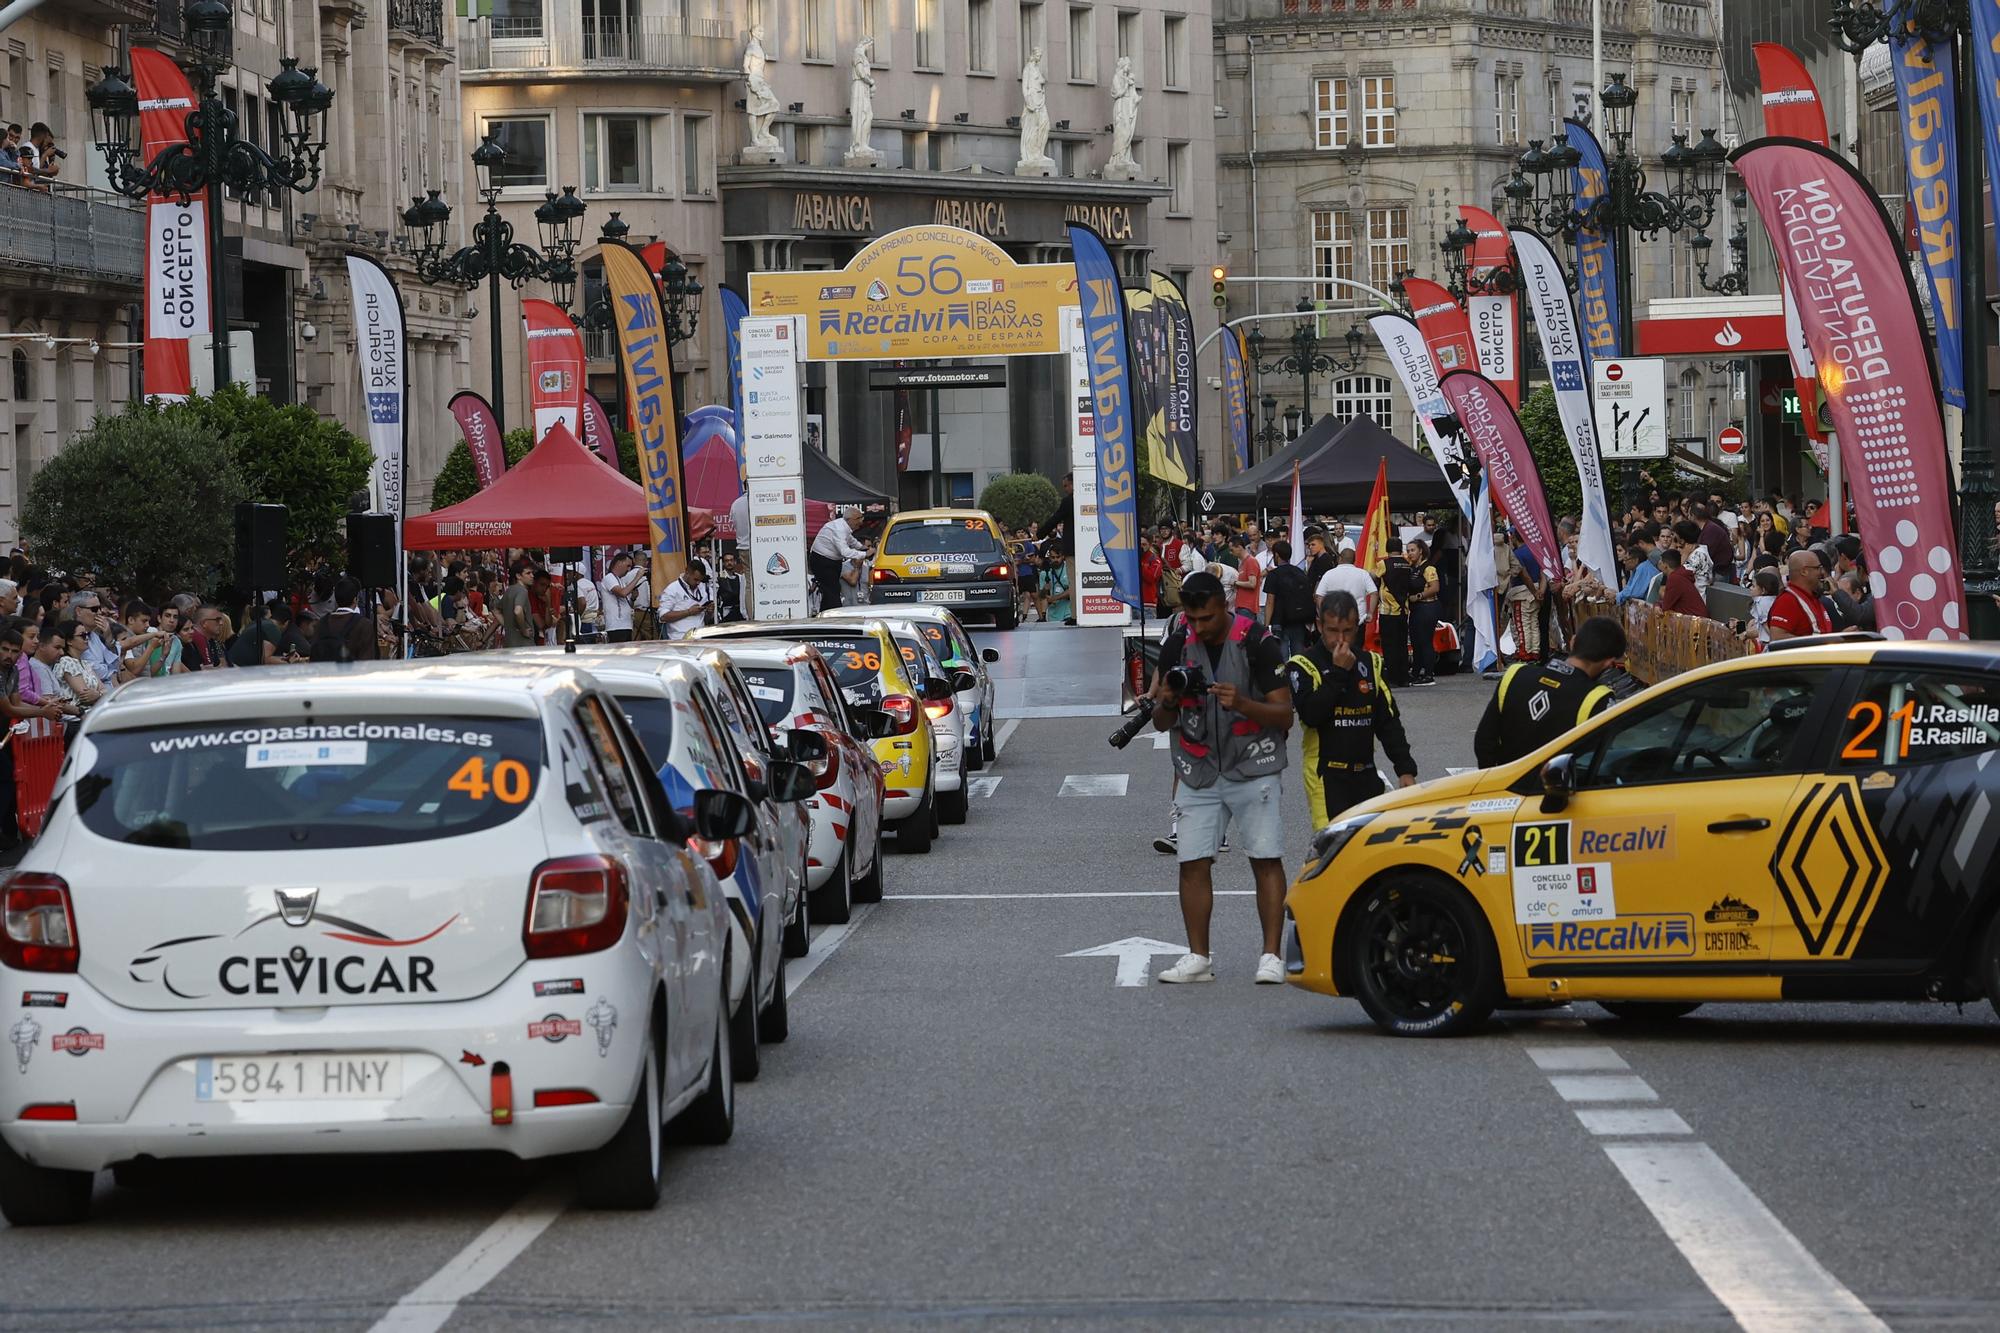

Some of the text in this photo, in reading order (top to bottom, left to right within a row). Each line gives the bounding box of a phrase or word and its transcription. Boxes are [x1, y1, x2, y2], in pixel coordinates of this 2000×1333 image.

[800, 195, 874, 232] ABANCA
[942, 200, 1007, 236] ABANCA
[1443, 187, 1451, 233] POPU
[1428, 188, 1437, 282] UNIVERSID
[856, 232, 1001, 273] GRAN PREMIO CONCELLO DE VIGO
[896, 254, 963, 297] 56
[866, 303, 908, 313] RALLYE
[976, 298, 1017, 315] RÍAS
[844, 308, 945, 336] Recalvi
[976, 313, 1043, 331] BAIXAS
[923, 330, 1043, 344] COPA DE ESPAÑA
[899, 372, 989, 384] www.fotomotor.es
[758, 454, 776, 463] cde
[465, 519, 512, 529] DEPUTACIÓN
[763, 516, 789, 524] Recalvi
[964, 519, 984, 530] 32
[464, 528, 512, 536] PONTEVEDRA
[781, 535, 798, 543] VIGO
[915, 553, 979, 563] COPLEGAL
[923, 592, 944, 601] 2280
[947, 591, 963, 600] GTB
[847, 651, 880, 671] 36
[901, 647, 915, 661] 5
[1841, 699, 1999, 758] 21 J.Rasilla
[1909, 727, 1987, 745] B.Rasilla
[150, 721, 493, 754] www.copasnacionales.es
[1247, 737, 1276, 758] 25
[1256, 755, 1276, 765] FOTO
[447, 755, 531, 804] 40
[1470, 798, 1519, 809] MOBILIZE
[1524, 826, 1557, 865] 21
[1578, 825, 1667, 854] Recalvi
[1532, 874, 1572, 883] CONCELLO
[1537, 882, 1568, 891] DE VIGO
[1527, 901, 1603, 917] cde amura
[1558, 921, 1662, 951] Recalvi
[218, 955, 438, 995] CEVICAR
[1397, 1016, 1446, 1031] MICHELIN
[219, 1060, 389, 1094] 5841 HNY
